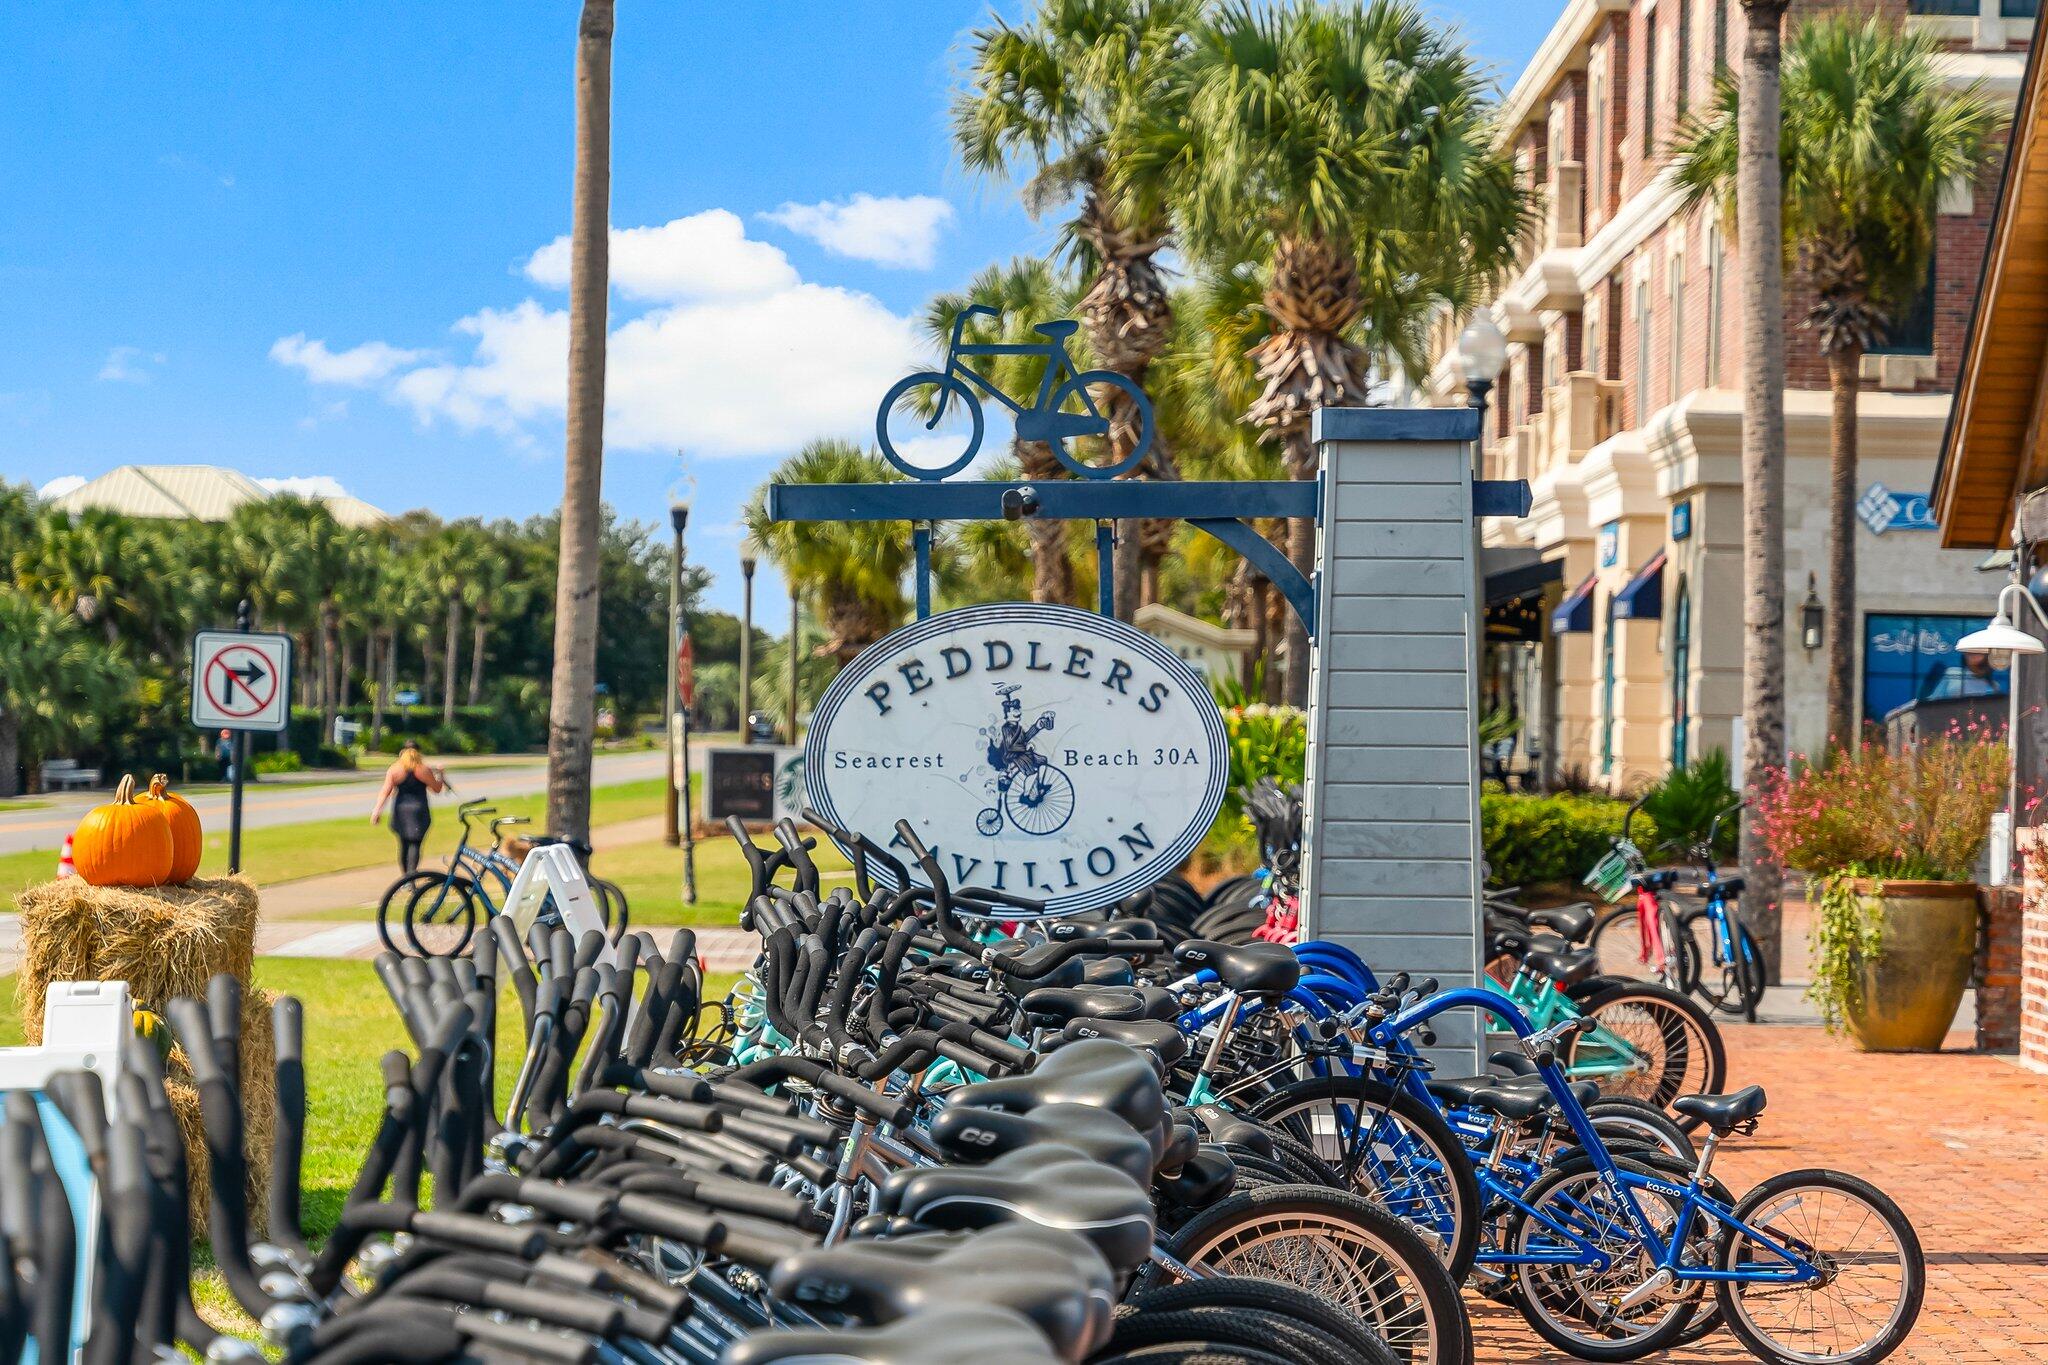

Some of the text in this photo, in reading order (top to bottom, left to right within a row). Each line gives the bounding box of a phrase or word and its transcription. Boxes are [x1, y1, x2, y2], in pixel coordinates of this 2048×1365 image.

[865, 640, 1171, 716] PEDDLERS
[834, 748, 1200, 769] Seacrest Beach 30A
[1185, 950, 1207, 961] C9
[1078, 1027, 1100, 1039] C9
[1400, 1152, 1443, 1222] BURLEY
[1645, 1180, 1681, 1198] kazoo
[1603, 1169, 1648, 1239] BURLEY
